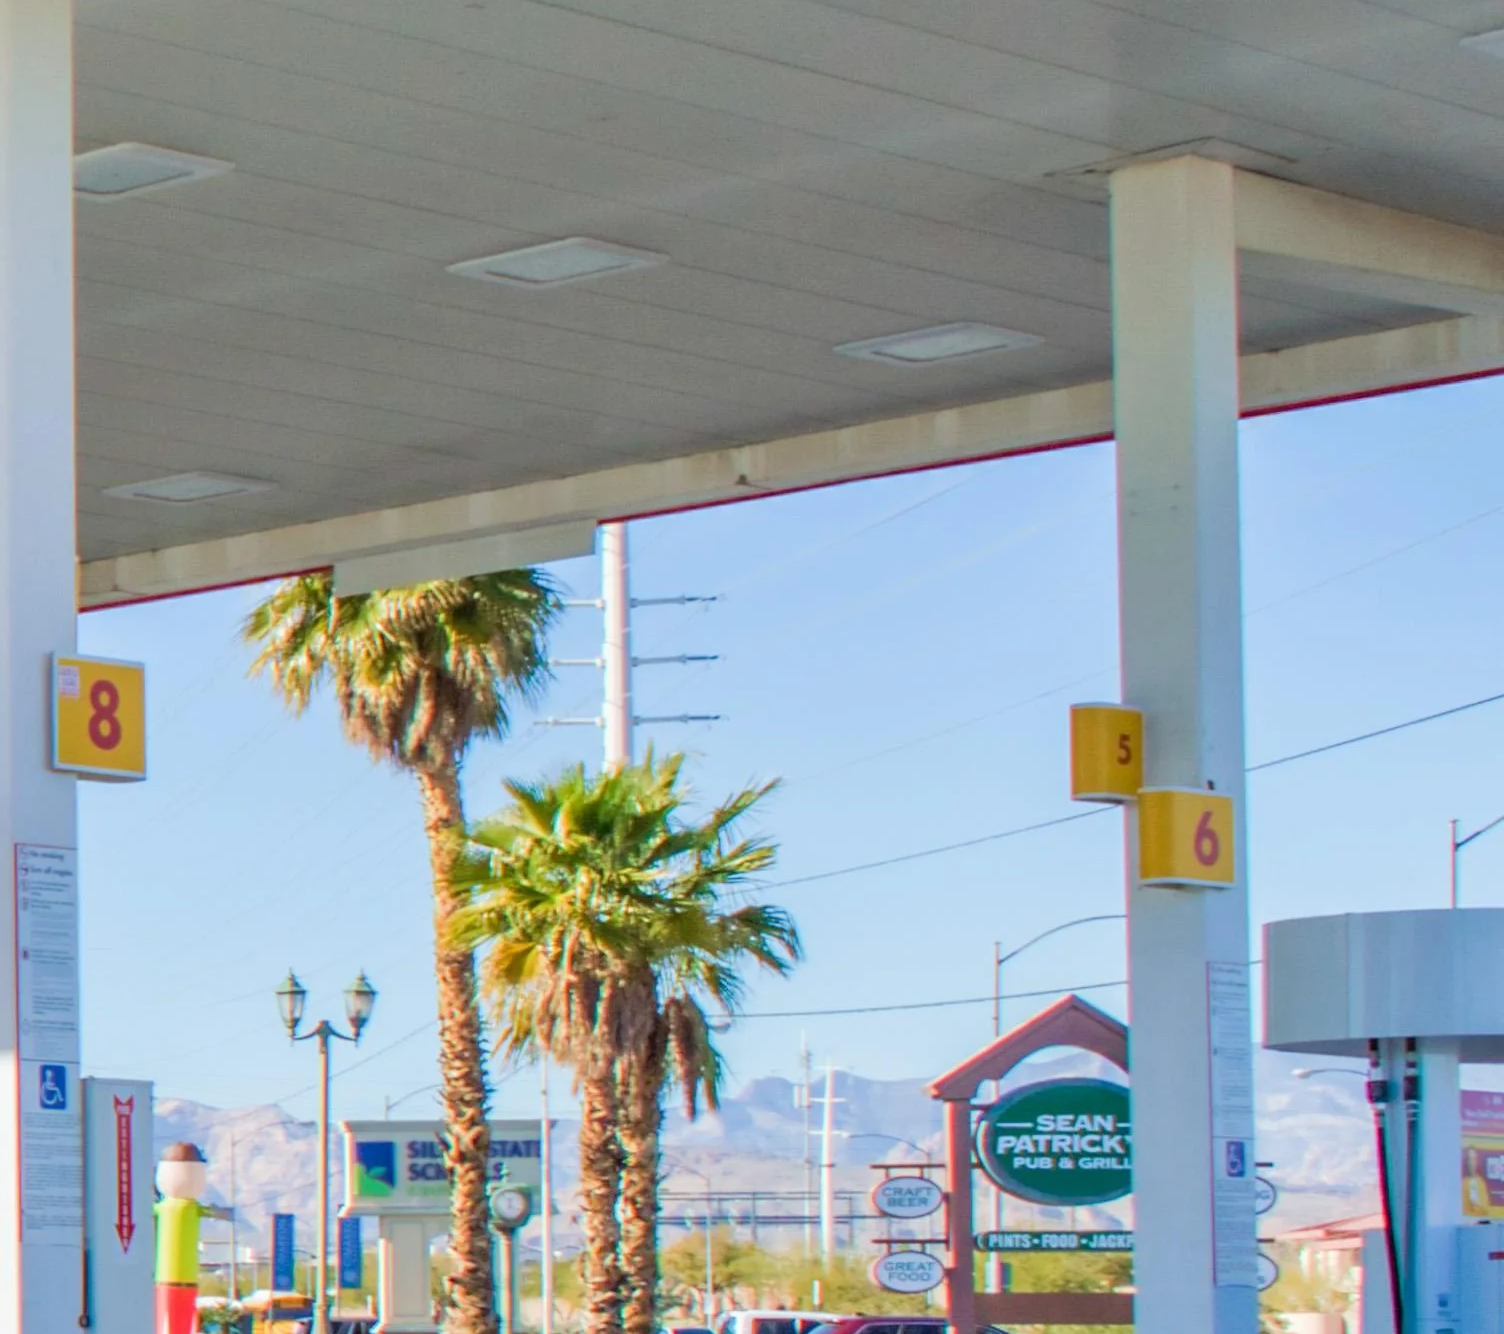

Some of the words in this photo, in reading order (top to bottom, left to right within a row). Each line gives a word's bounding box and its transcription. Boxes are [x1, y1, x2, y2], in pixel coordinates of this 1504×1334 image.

[88, 679, 122, 751] 8
[1117, 733, 1131, 765] 5
[1194, 810, 1220, 867] 6
[1035, 1114, 1115, 1132] SEAN
[996, 1134, 1132, 1155] PATRICK'
[1013, 1157, 1053, 1169] PUB
[1058, 1157, 1074, 1169] &
[1078, 1157, 1132, 1170] GRILL
[881, 1186, 932, 1197] CRAFT
[887, 1197, 928, 1208] BEER
[988, 1234, 1032, 1248] PINTS
[1041, 1234, 1078, 1248] FOOD
[884, 1261, 935, 1272] GREAT
[888, 1272, 931, 1282] FOOD
